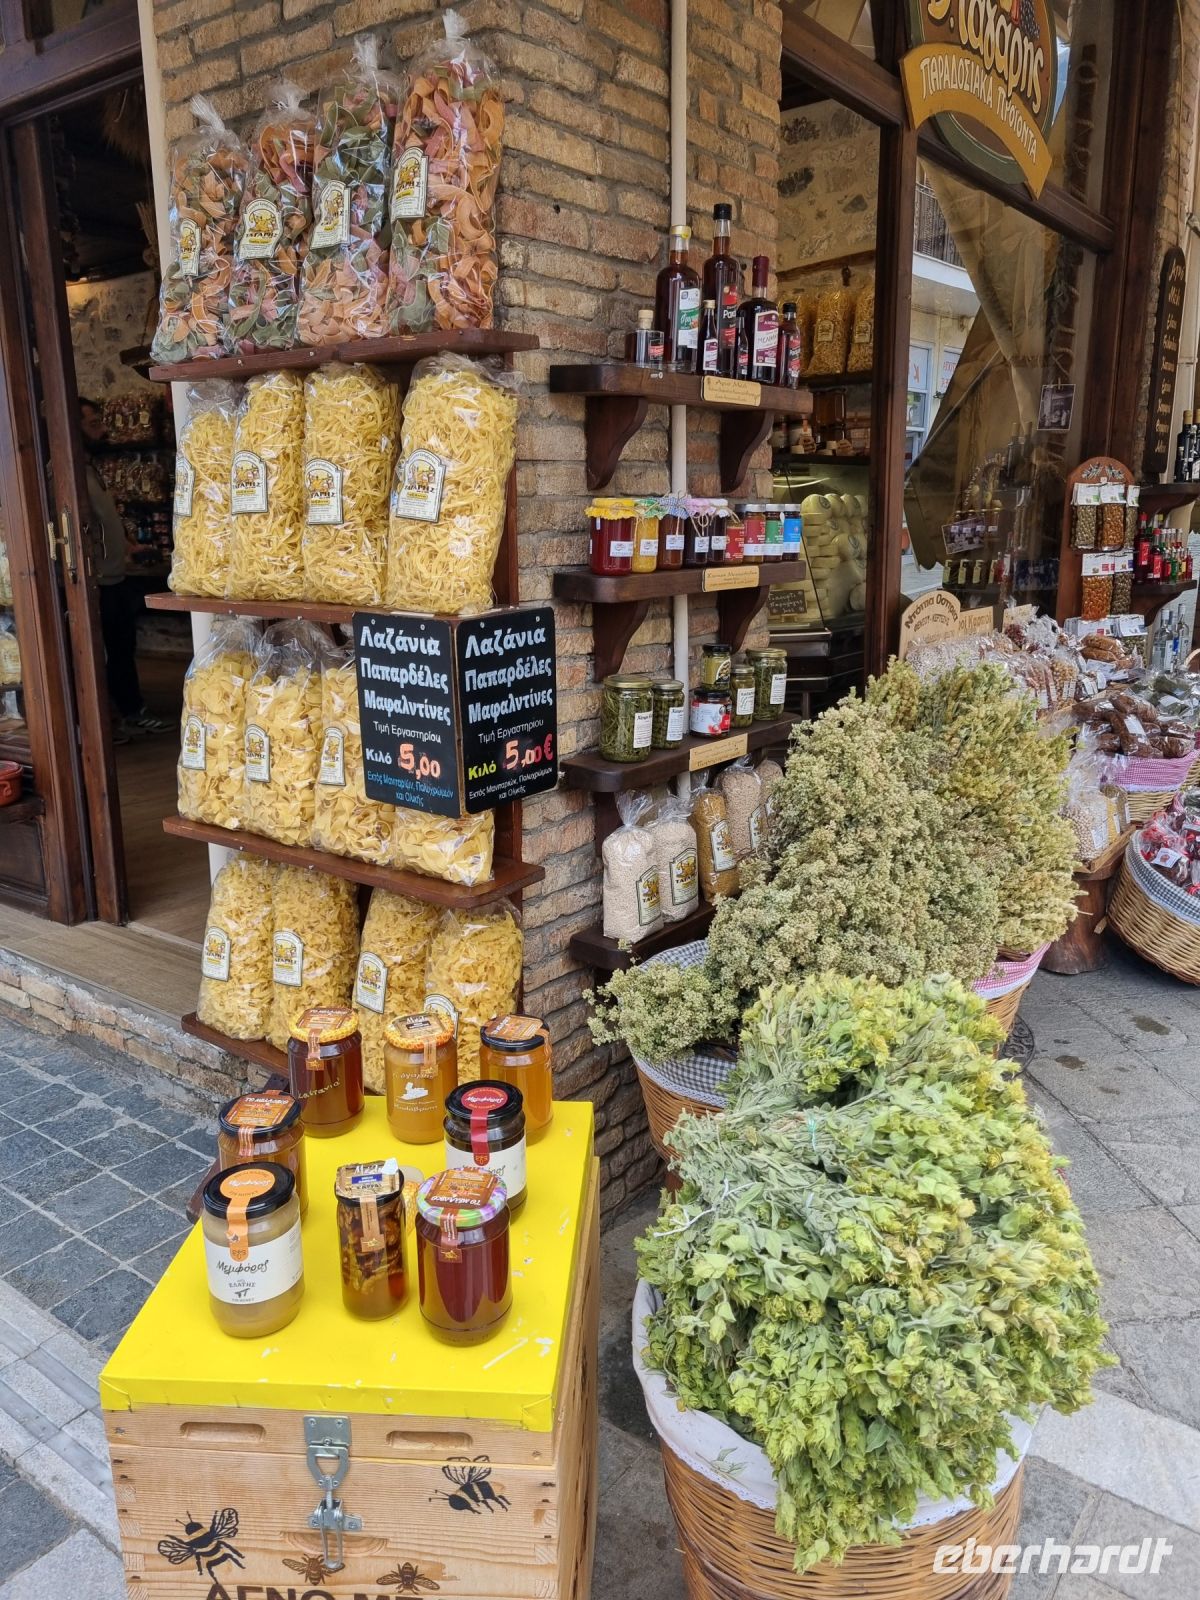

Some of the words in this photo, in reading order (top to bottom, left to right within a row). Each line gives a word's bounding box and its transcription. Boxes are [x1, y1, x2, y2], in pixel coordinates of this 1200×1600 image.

[920, 54, 993, 108] ΠΑΡΑΔΟΣΙΑΚΑ
[360, 626, 441, 656] Λαζάνια
[465, 627, 546, 658] Λαζάνια
[361, 657, 449, 694] Παπαρδέλες
[465, 656, 552, 692] Παπαρδέλες
[364, 689, 452, 725] Μαφαλντίνες
[468, 688, 553, 724] Μαφαλντίνες
[373, 721, 389, 735] Τιμή
[478, 730, 496, 744] Τιμή
[366, 748, 392, 764] Κιλό
[400, 743, 440, 780] 5,00
[468, 760, 496, 780] Κιλό
